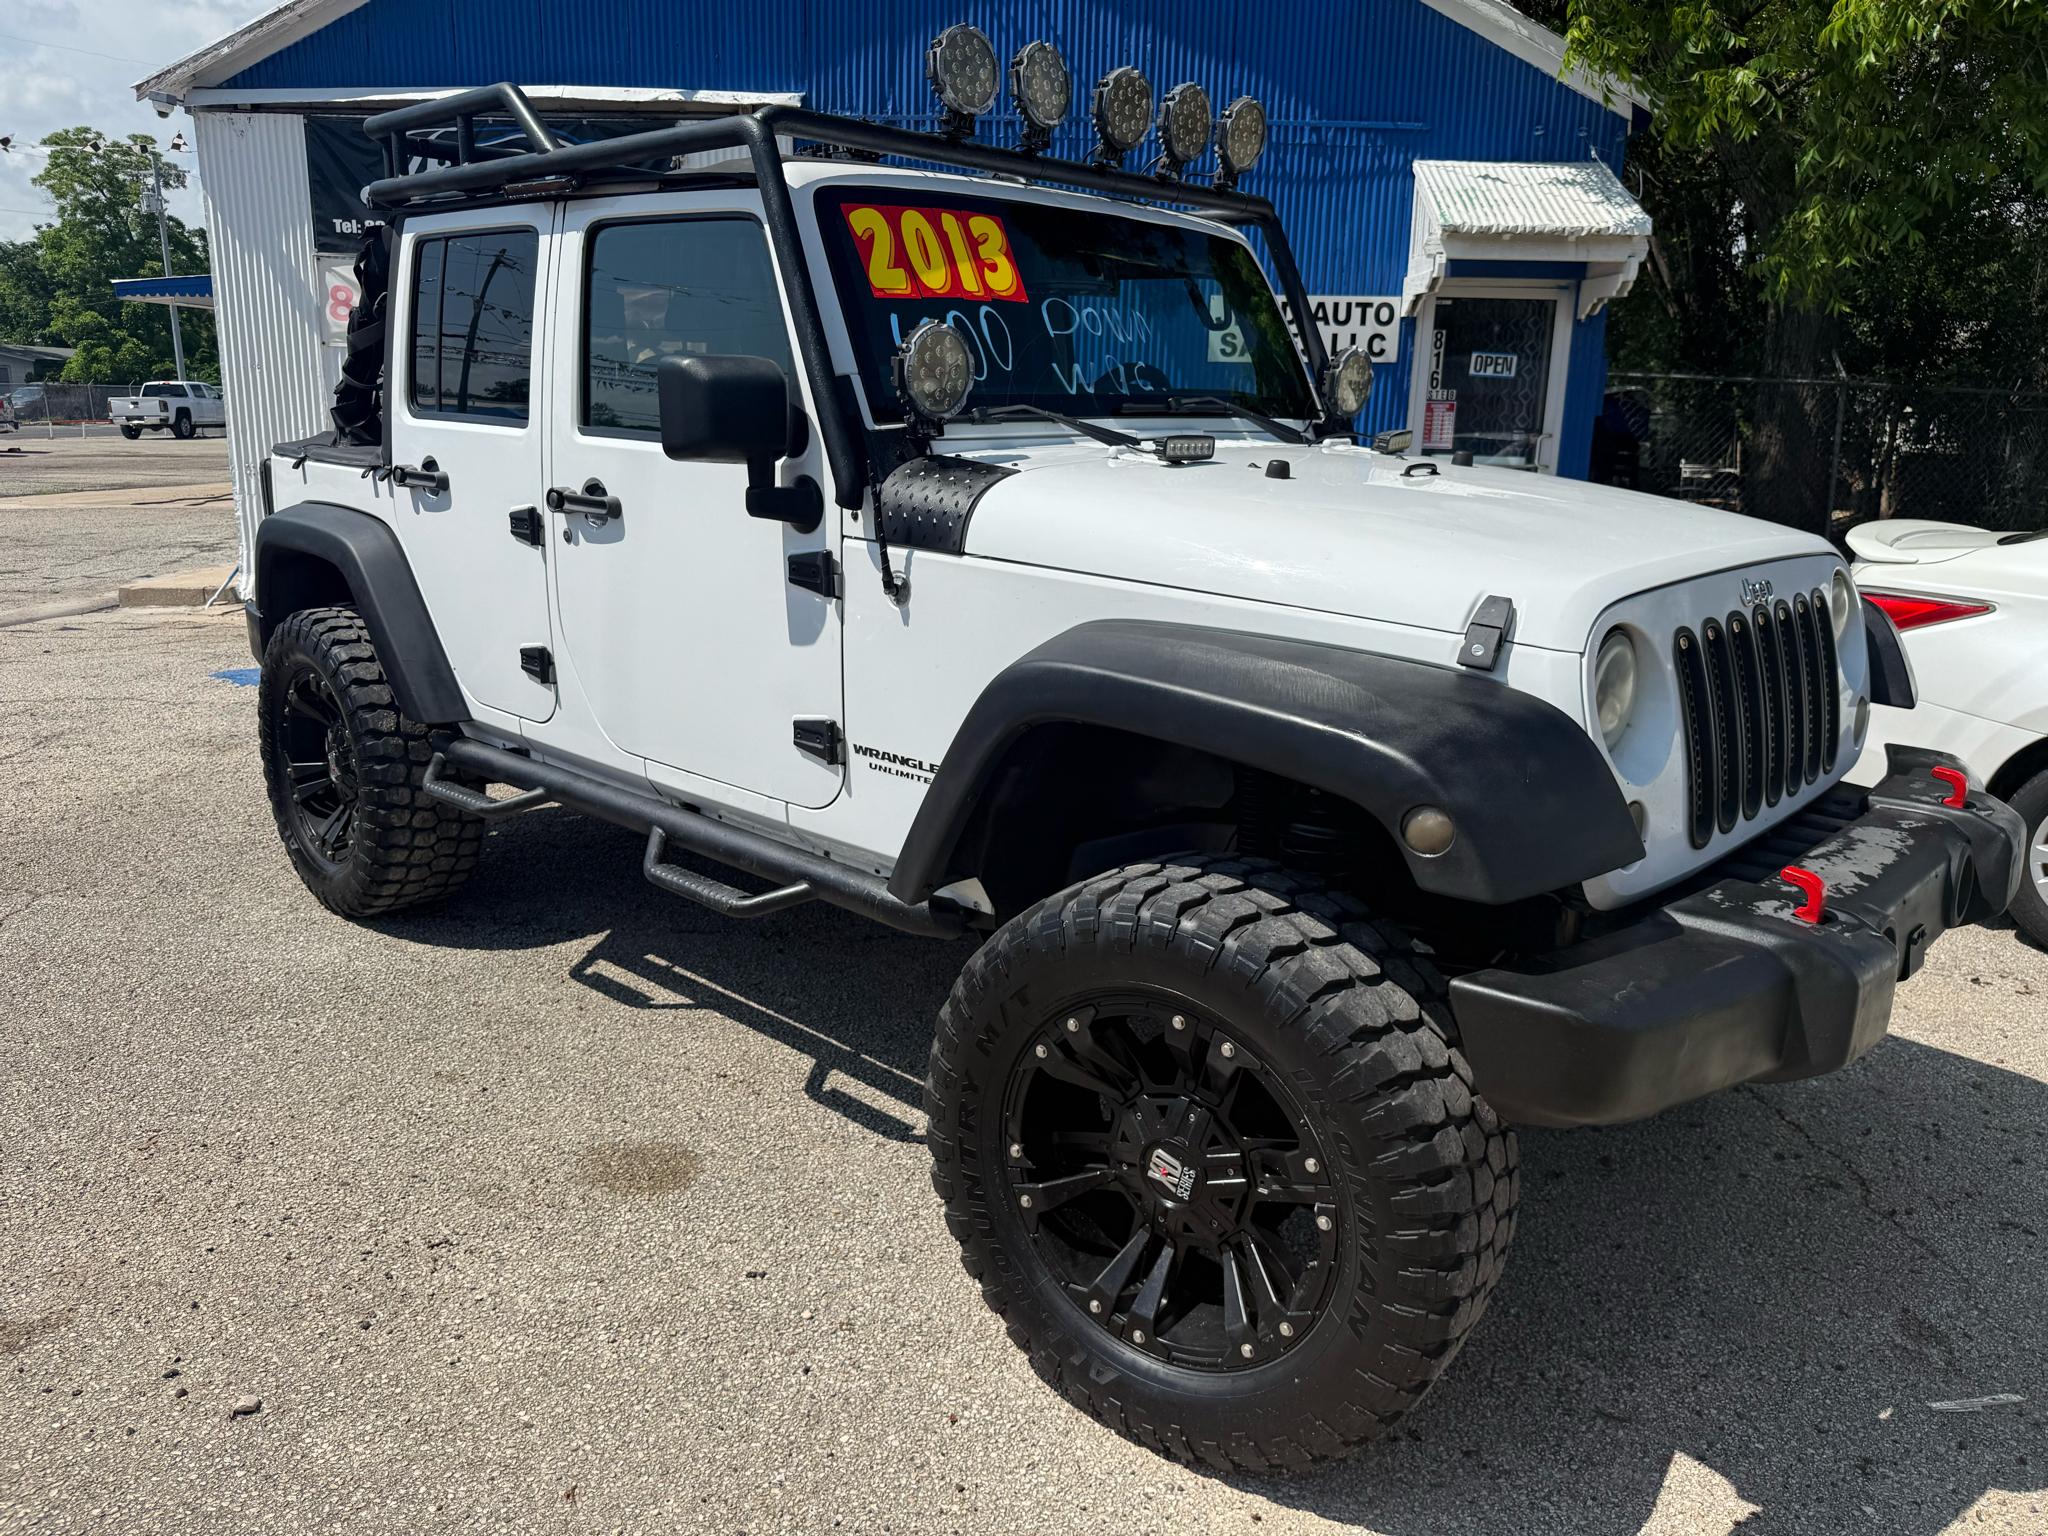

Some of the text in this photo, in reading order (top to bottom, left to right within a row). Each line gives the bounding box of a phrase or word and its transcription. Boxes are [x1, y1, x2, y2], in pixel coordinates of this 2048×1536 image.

[332, 218, 362, 234] Tel:
[848, 206, 1018, 296] 2013
[1314, 302, 1395, 326] AUTO
[1473, 353, 1513, 374] OPEN
[1740, 578, 1774, 607] Jeep
[853, 743, 940, 774] WRANGLE
[869, 762, 933, 785] UNLIMITE
